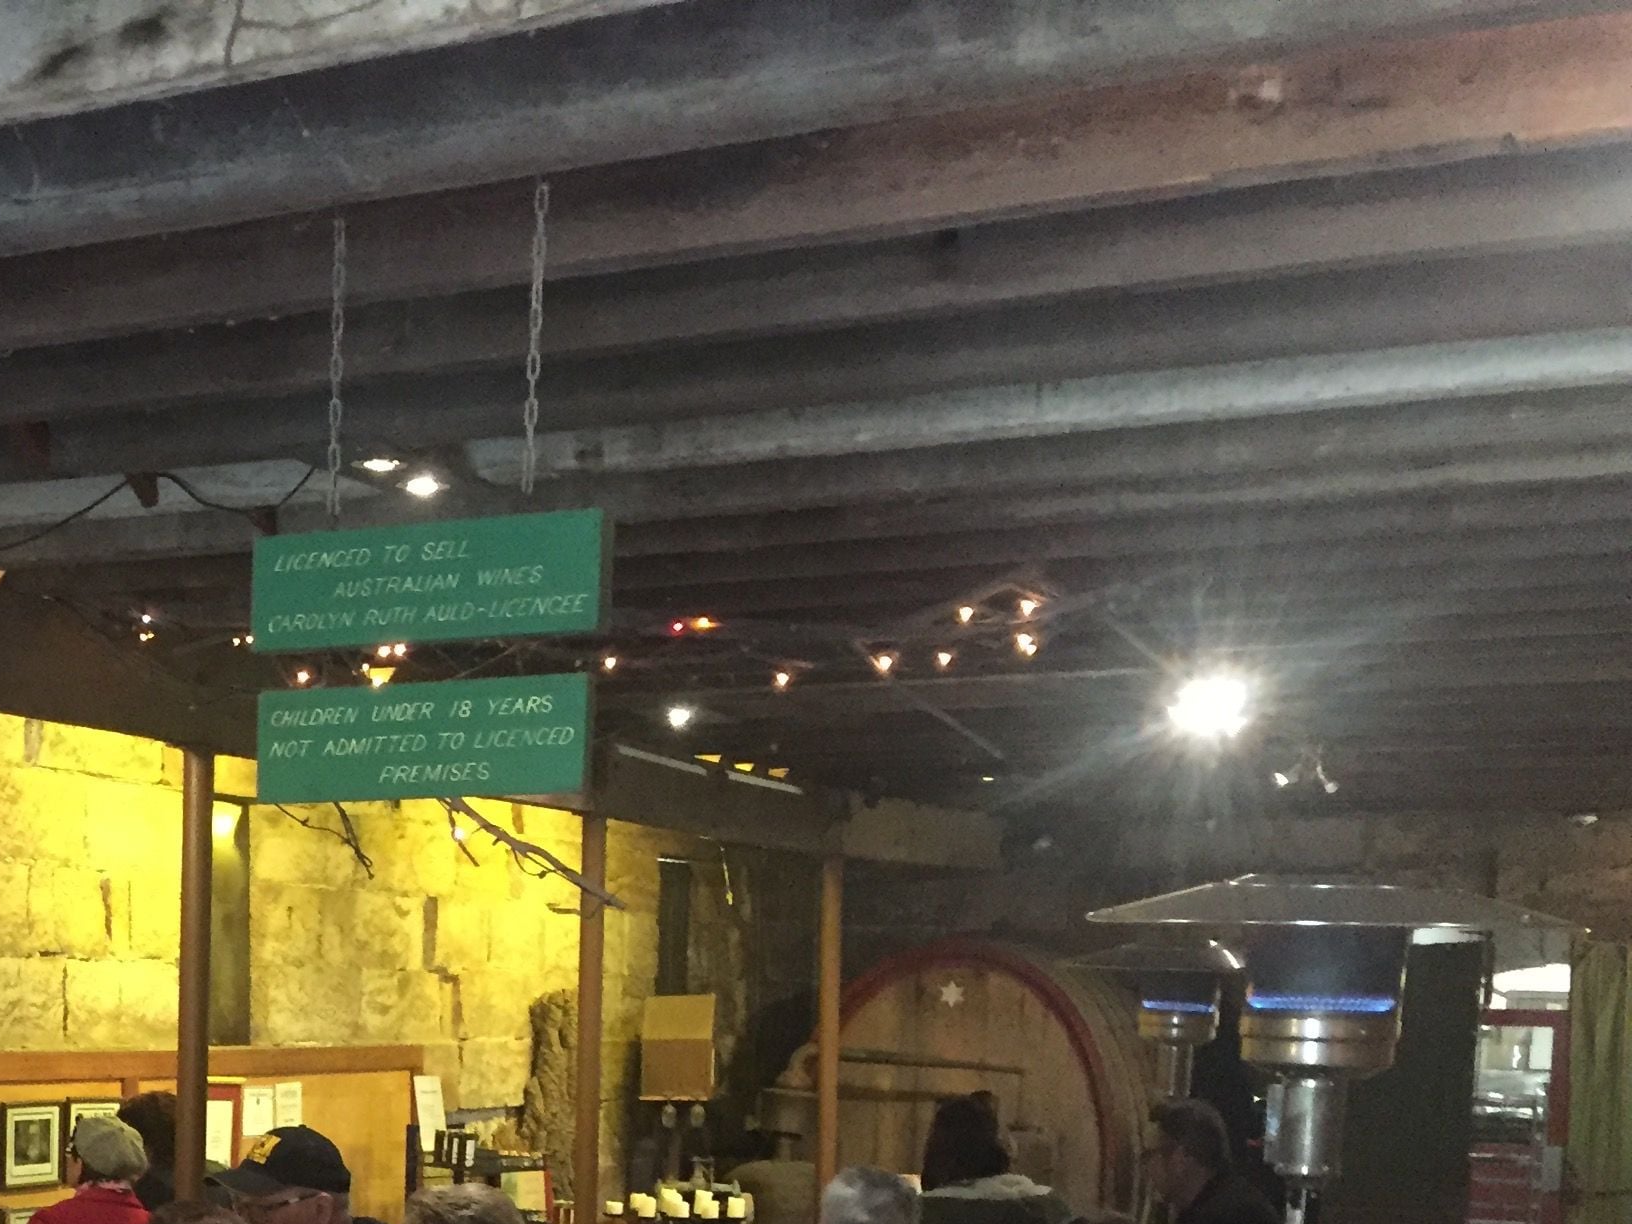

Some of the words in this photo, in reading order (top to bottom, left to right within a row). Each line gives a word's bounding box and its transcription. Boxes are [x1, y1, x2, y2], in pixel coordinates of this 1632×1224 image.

[273, 547, 371, 572] LICENCED
[383, 544, 412, 564] TO
[421, 540, 469, 561] SELL
[333, 572, 461, 598] AUSTRALIAN
[477, 564, 544, 587] WINES
[268, 610, 357, 634] CAROLYN
[363, 606, 417, 626] RUTH
[271, 707, 358, 727] CHILDREN
[371, 701, 435, 723] UNDER
[449, 699, 472, 719] 18
[488, 695, 554, 715] YEARS
[269, 738, 313, 759] NOT
[322, 733, 428, 758] ADMITTED
[438, 731, 465, 750] TO
[473, 726, 575, 749] LICENCED
[378, 761, 490, 784] PREMISES
